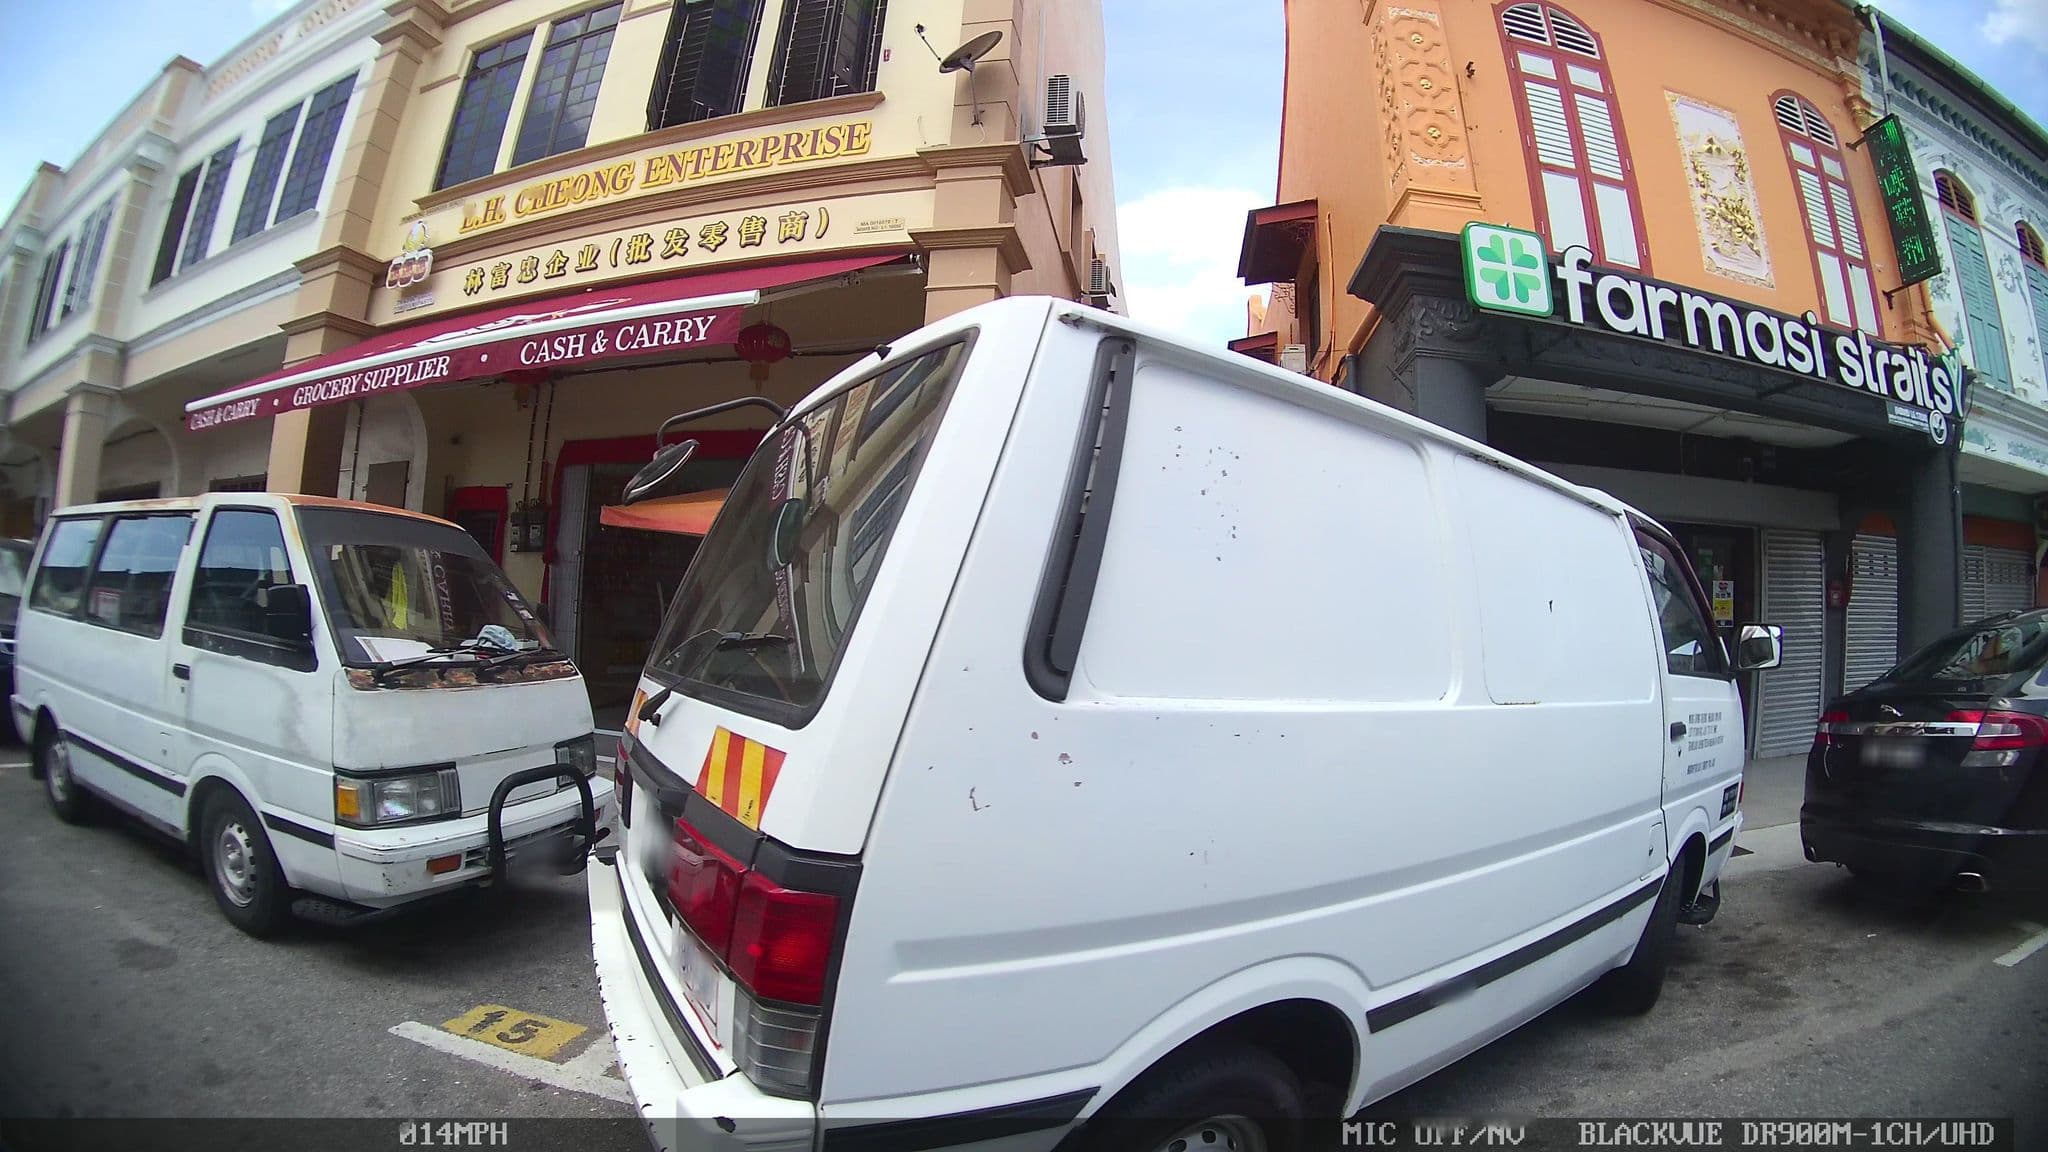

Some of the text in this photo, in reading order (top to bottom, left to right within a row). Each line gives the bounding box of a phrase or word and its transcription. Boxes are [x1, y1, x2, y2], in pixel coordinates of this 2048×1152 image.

[513, 161, 635, 215] CHEONG
[639, 119, 872, 189] ENTERPRISE
[293, 373, 362, 406] GROCERY
[361, 356, 450, 393] SUPPLIER
[519, 333, 585, 365] CASH
[590, 330, 609, 354] &
[615, 315, 717, 351] CARRY
[1556, 246, 1954, 416] farmasi straits
[468, 1010, 549, 1043] 15
